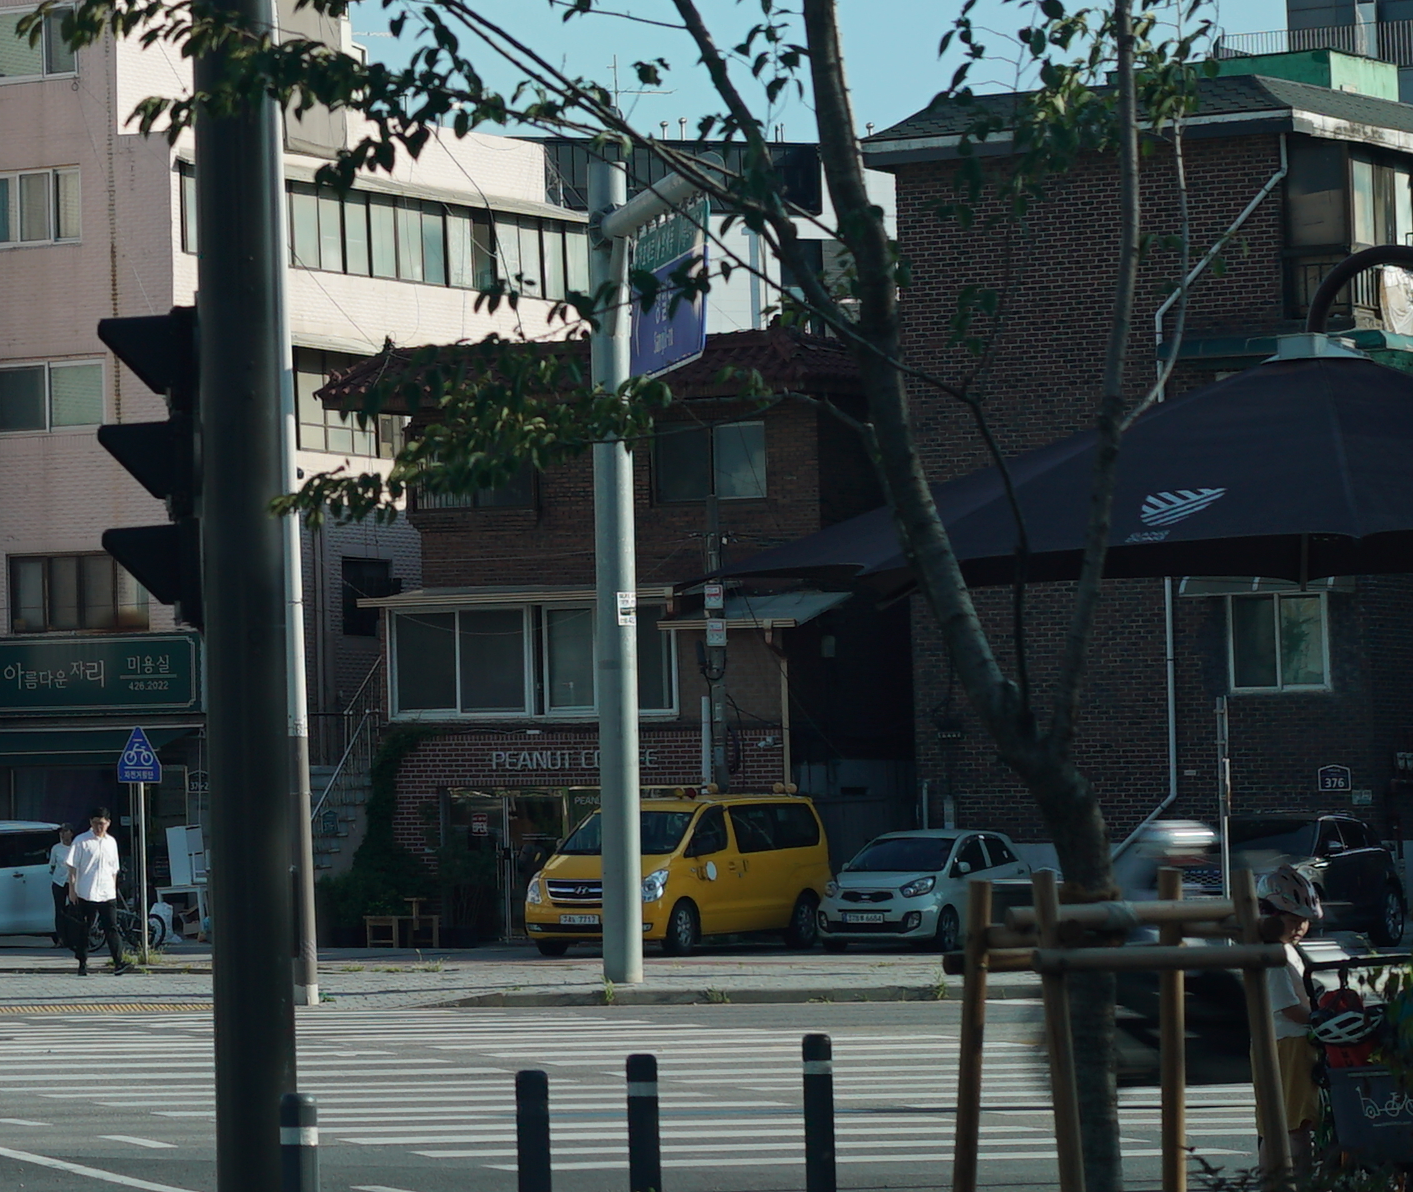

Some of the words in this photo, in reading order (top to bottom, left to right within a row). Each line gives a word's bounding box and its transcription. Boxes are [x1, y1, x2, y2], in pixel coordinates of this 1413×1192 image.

[127, 655, 171, 674] 미용실
[3, 662, 67, 690] 아름다운
[70, 660, 105, 688] 자리
[128, 681, 169, 691] 426.2022
[491, 750, 570, 770] PEANUT
[580, 749, 659, 769] COEE
[1325, 777, 1346, 789] 376
